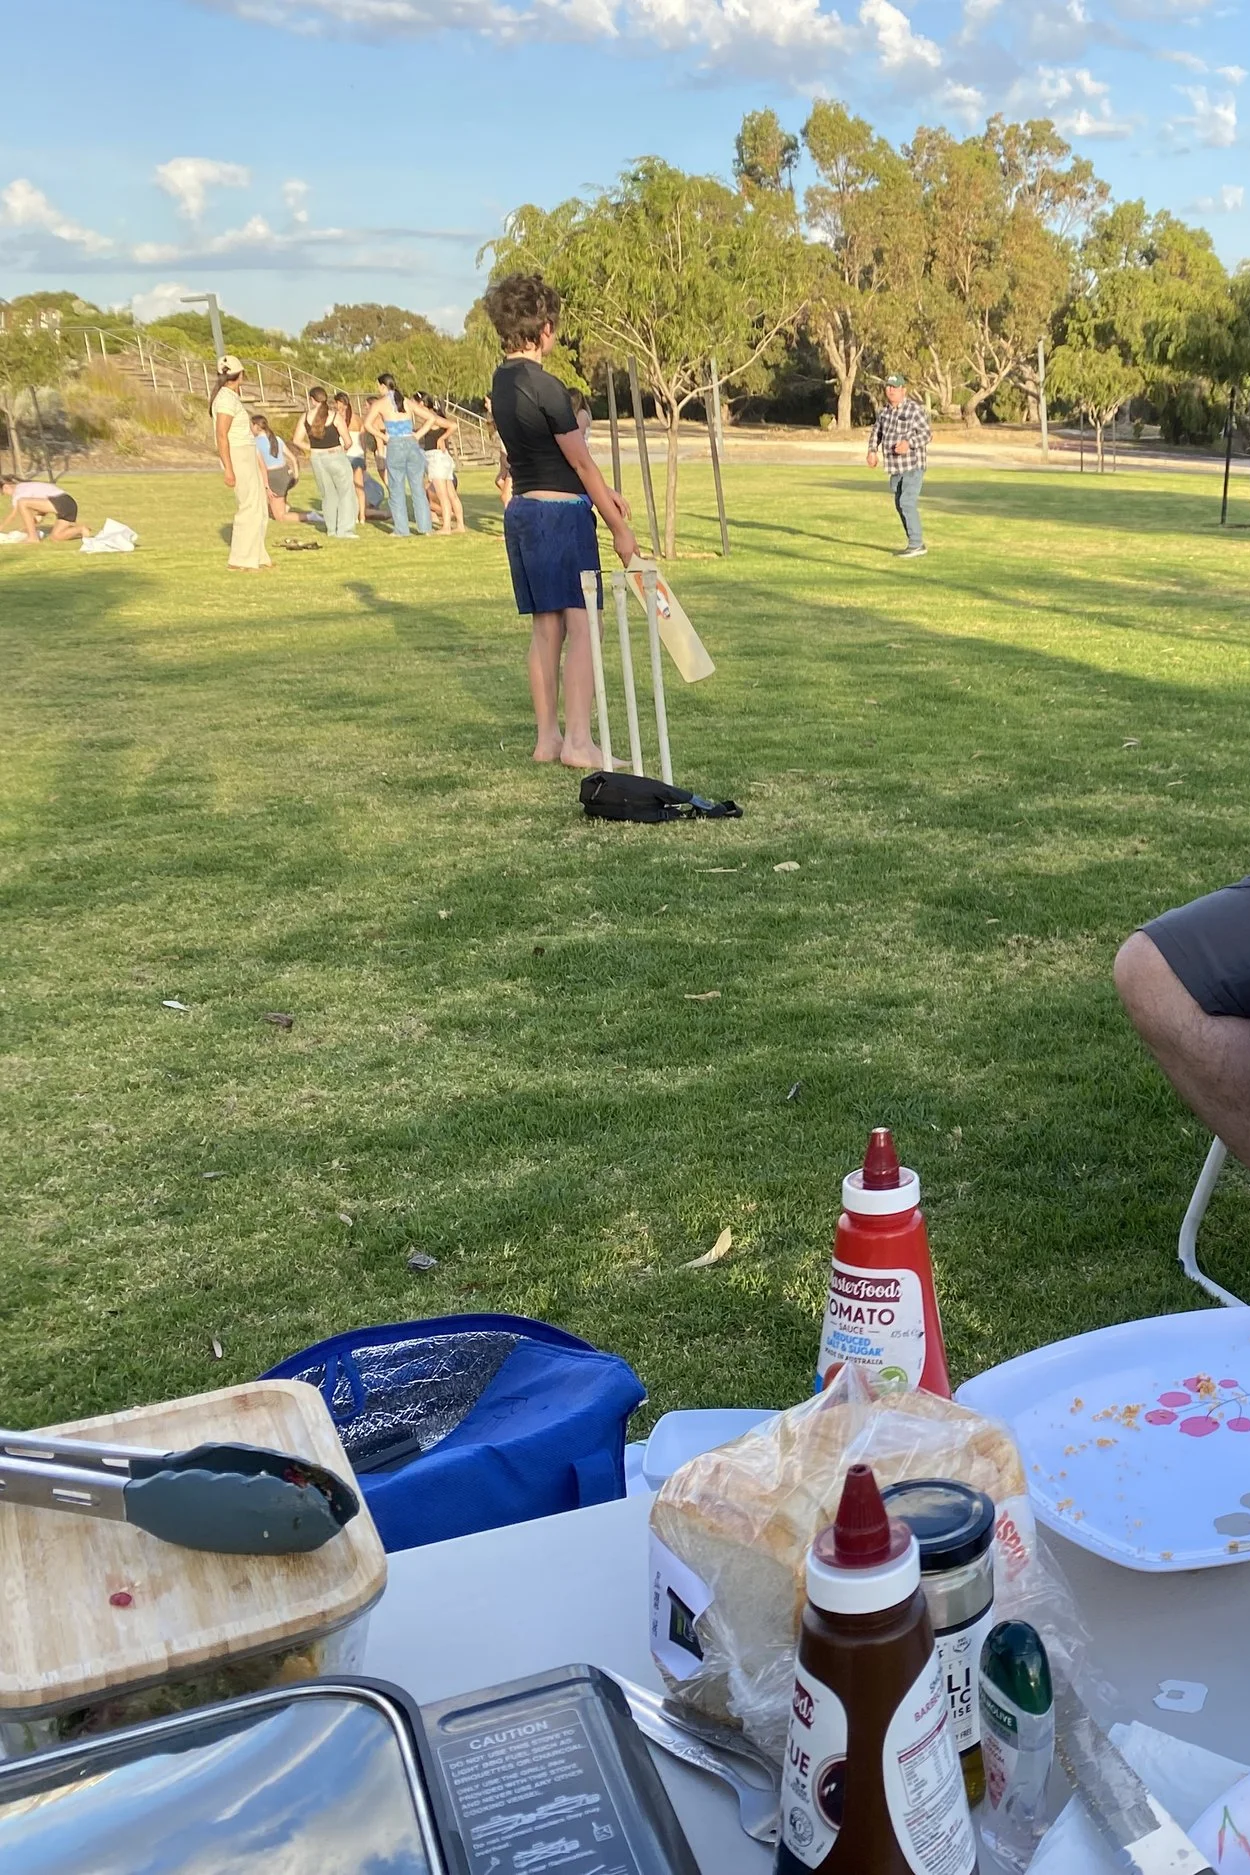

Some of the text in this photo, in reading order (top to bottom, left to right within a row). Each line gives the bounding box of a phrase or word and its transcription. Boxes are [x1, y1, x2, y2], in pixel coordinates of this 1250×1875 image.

[832, 1275, 901, 1299] asterFoods
[828, 1296, 894, 1326] OMATO
[839, 1322, 864, 1335] SAUCE
[469, 1720, 549, 1750] CAUTION
[449, 1761, 463, 1769] DO
[465, 1755, 485, 1765] NOT
[790, 1739, 810, 1777] UE
